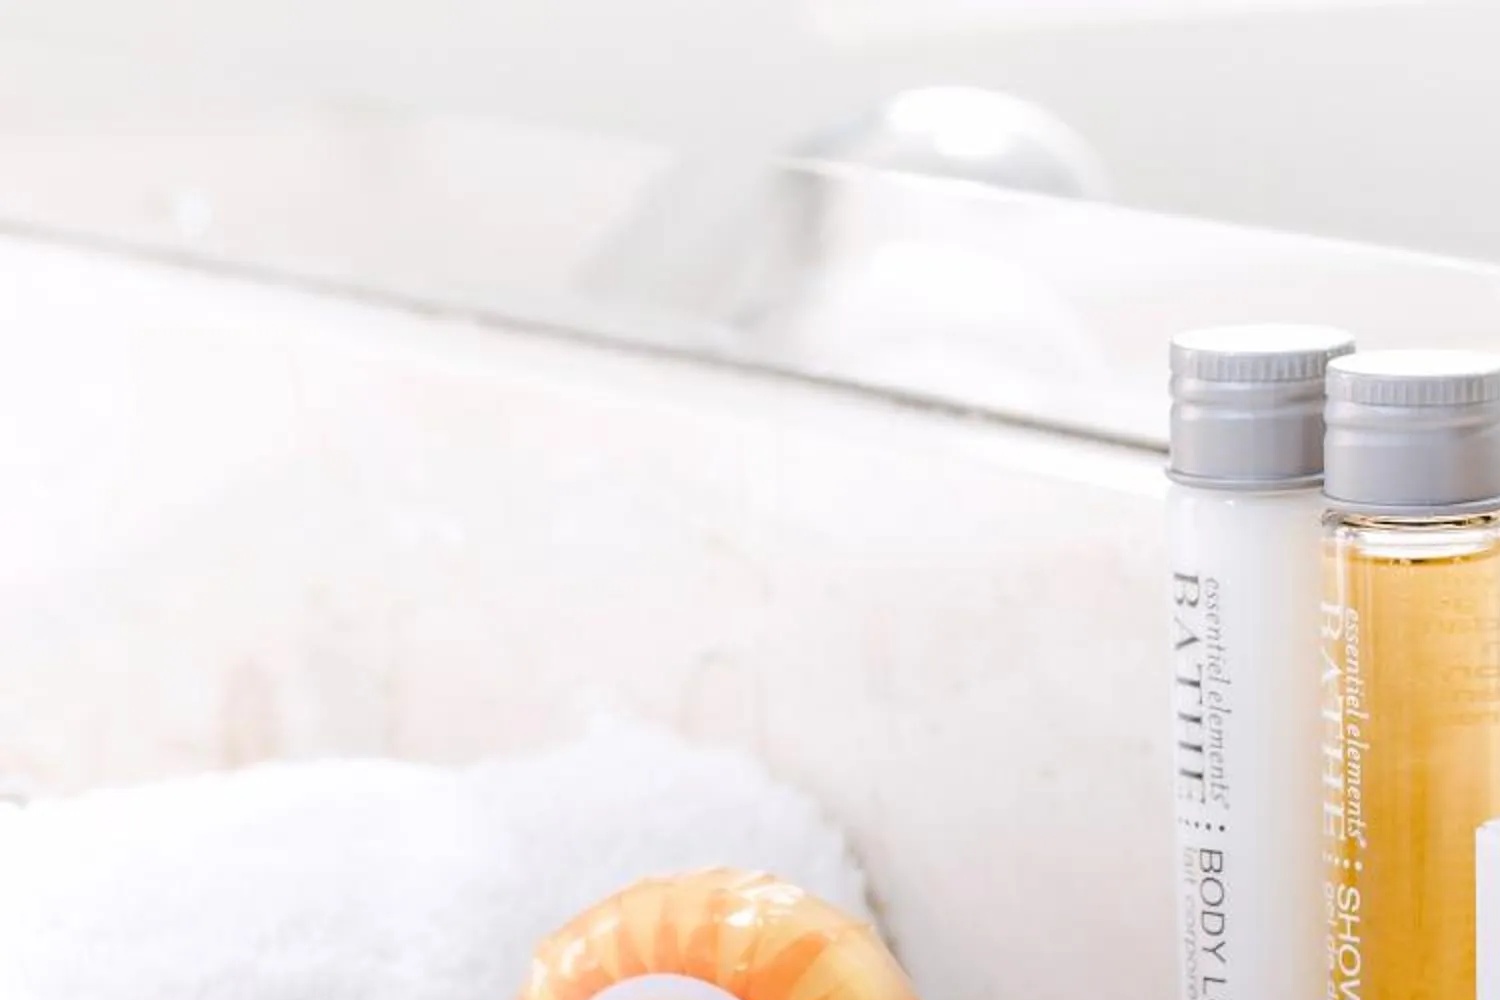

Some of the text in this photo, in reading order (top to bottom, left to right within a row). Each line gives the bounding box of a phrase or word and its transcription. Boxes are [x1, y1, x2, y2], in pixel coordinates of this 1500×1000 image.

[1174, 572, 1206, 805] BATHE
[1205, 576, 1232, 685] essentiel
[1345, 607, 1370, 720] essentiel
[1320, 601, 1347, 841] BATHE
[1200, 847, 1226, 964] BODY
